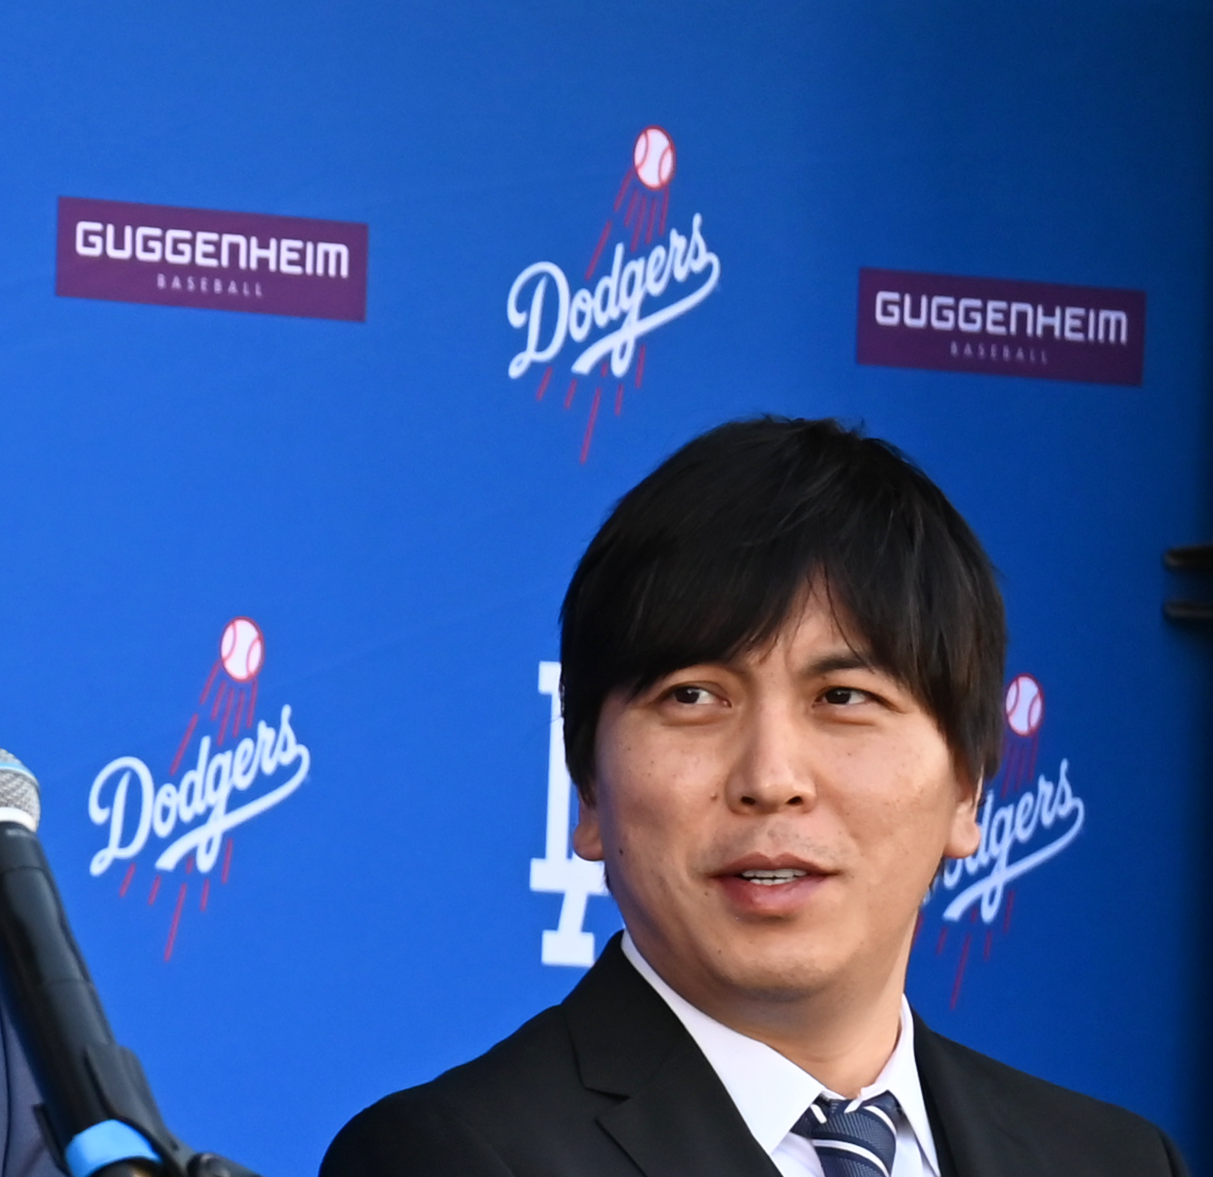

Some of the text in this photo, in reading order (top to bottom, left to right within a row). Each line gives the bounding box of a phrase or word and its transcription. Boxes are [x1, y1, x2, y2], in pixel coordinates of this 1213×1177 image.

[76, 220, 349, 279] GUGGENHEIM
[157, 273, 264, 298] BASEBALL
[507, 212, 720, 379] Dodgers
[875, 291, 1128, 345] GUGGENHEIM
[89, 703, 310, 877] Dodgers
